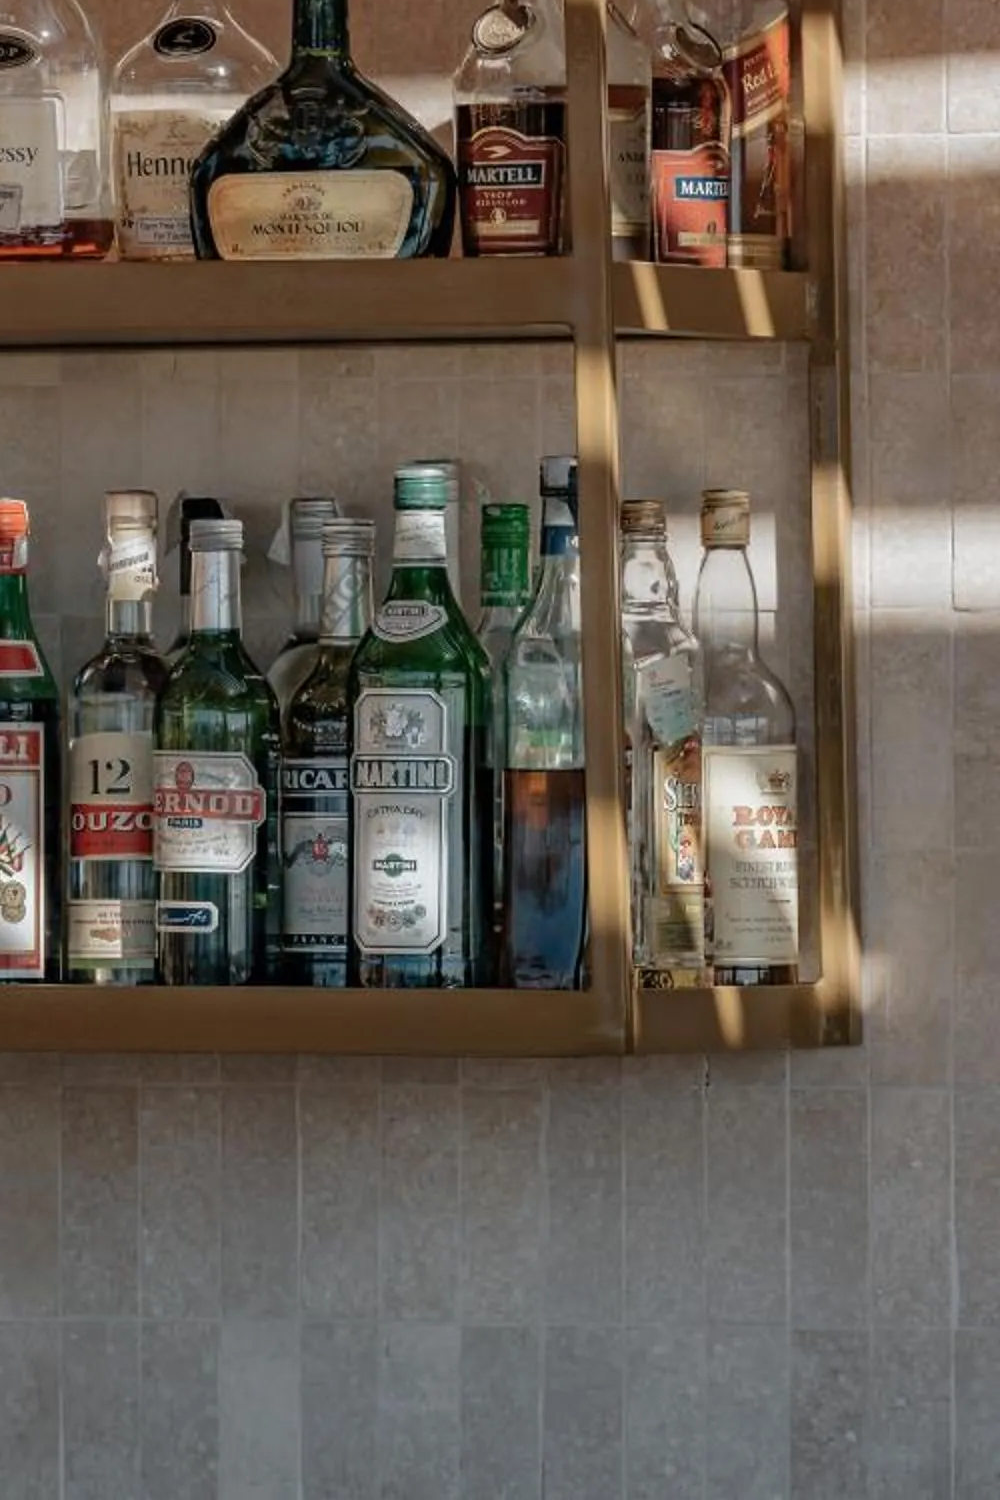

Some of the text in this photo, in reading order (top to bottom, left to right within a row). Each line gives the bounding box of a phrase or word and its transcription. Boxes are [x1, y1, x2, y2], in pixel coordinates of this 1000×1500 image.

[467, 167, 538, 183] MARTELL
[89, 758, 132, 795] 12
[356, 761, 448, 787] MARTINI
[72, 810, 152, 832] OUZO
